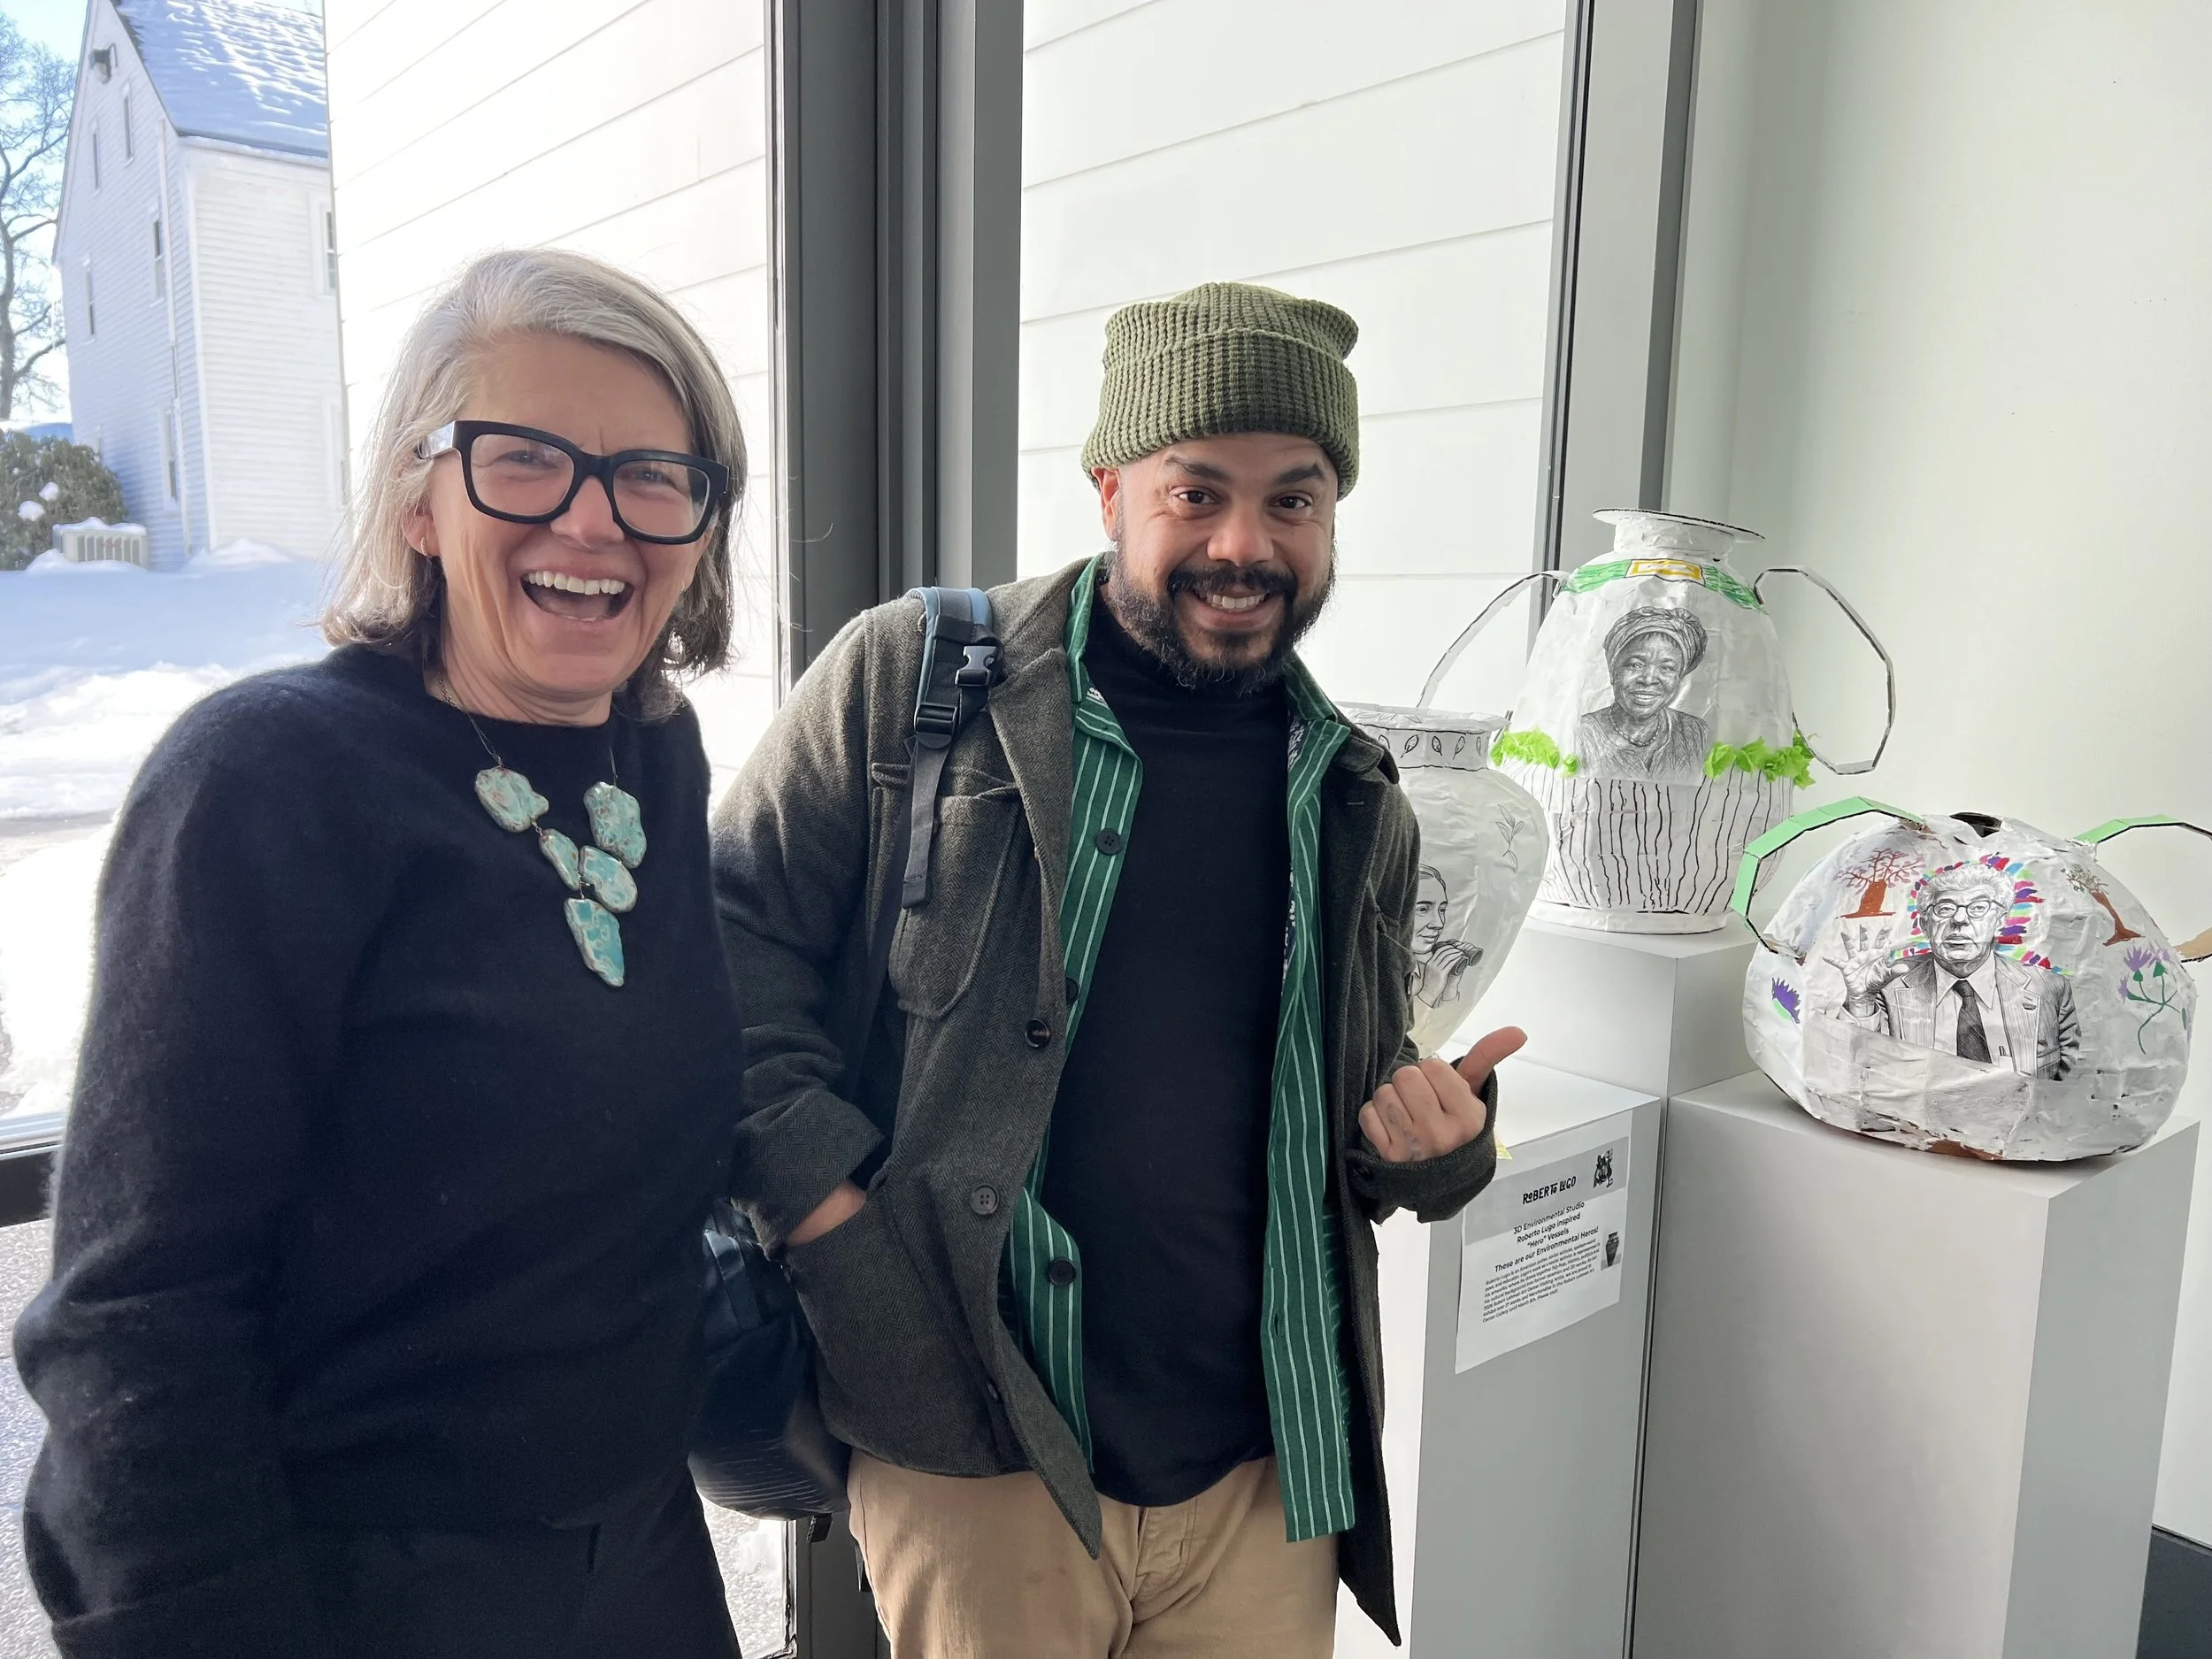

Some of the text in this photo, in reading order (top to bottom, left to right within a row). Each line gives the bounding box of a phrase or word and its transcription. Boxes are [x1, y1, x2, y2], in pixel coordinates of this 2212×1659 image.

[1513, 1202, 1585, 1234] 3D Environmental Studio
[1517, 1211, 1580, 1243] Roberto Lugo inspired
[1548, 1227, 1570, 1240] Vessels
[1494, 1226, 1599, 1272] These are our Environmental Heros!
